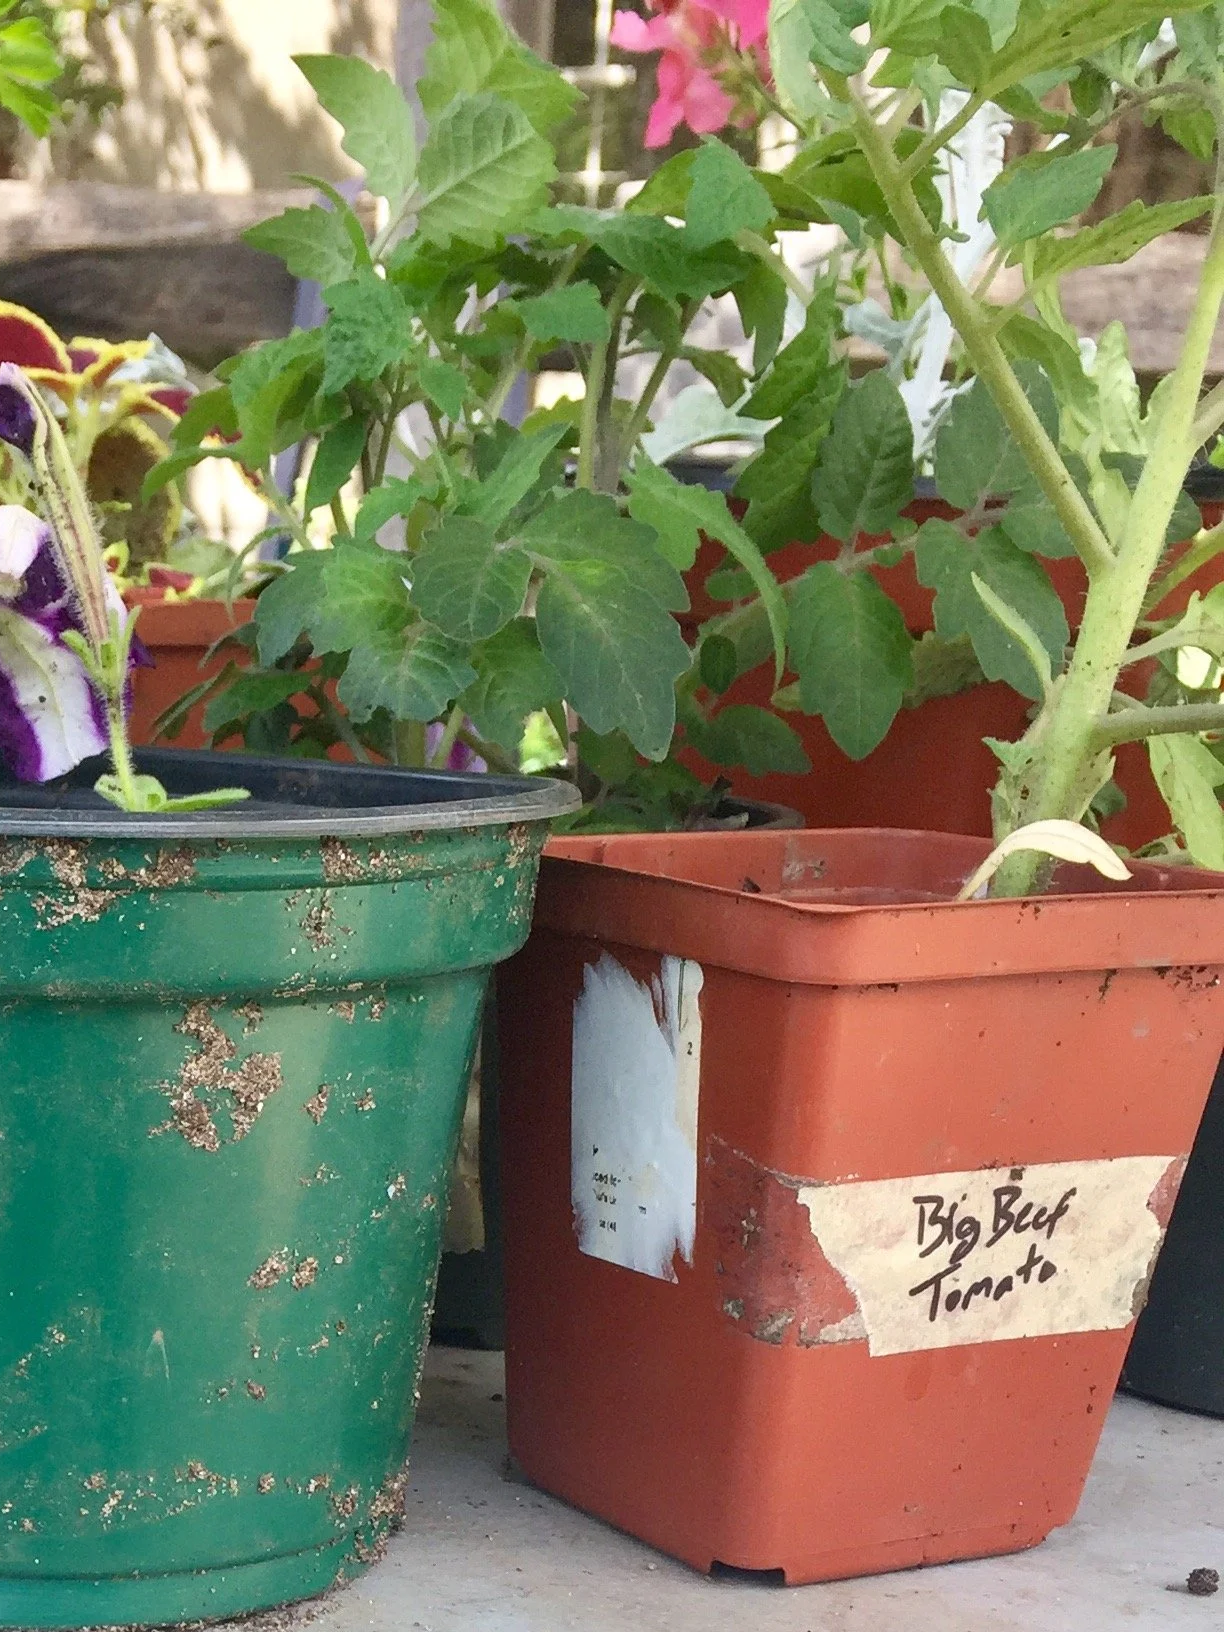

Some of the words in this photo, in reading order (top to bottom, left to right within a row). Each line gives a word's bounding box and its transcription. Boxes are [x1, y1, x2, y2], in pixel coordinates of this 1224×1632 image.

[912, 1192, 981, 1265] Big
[985, 1185, 1077, 1248] Beef
[908, 1243, 1057, 1322] Tomato
